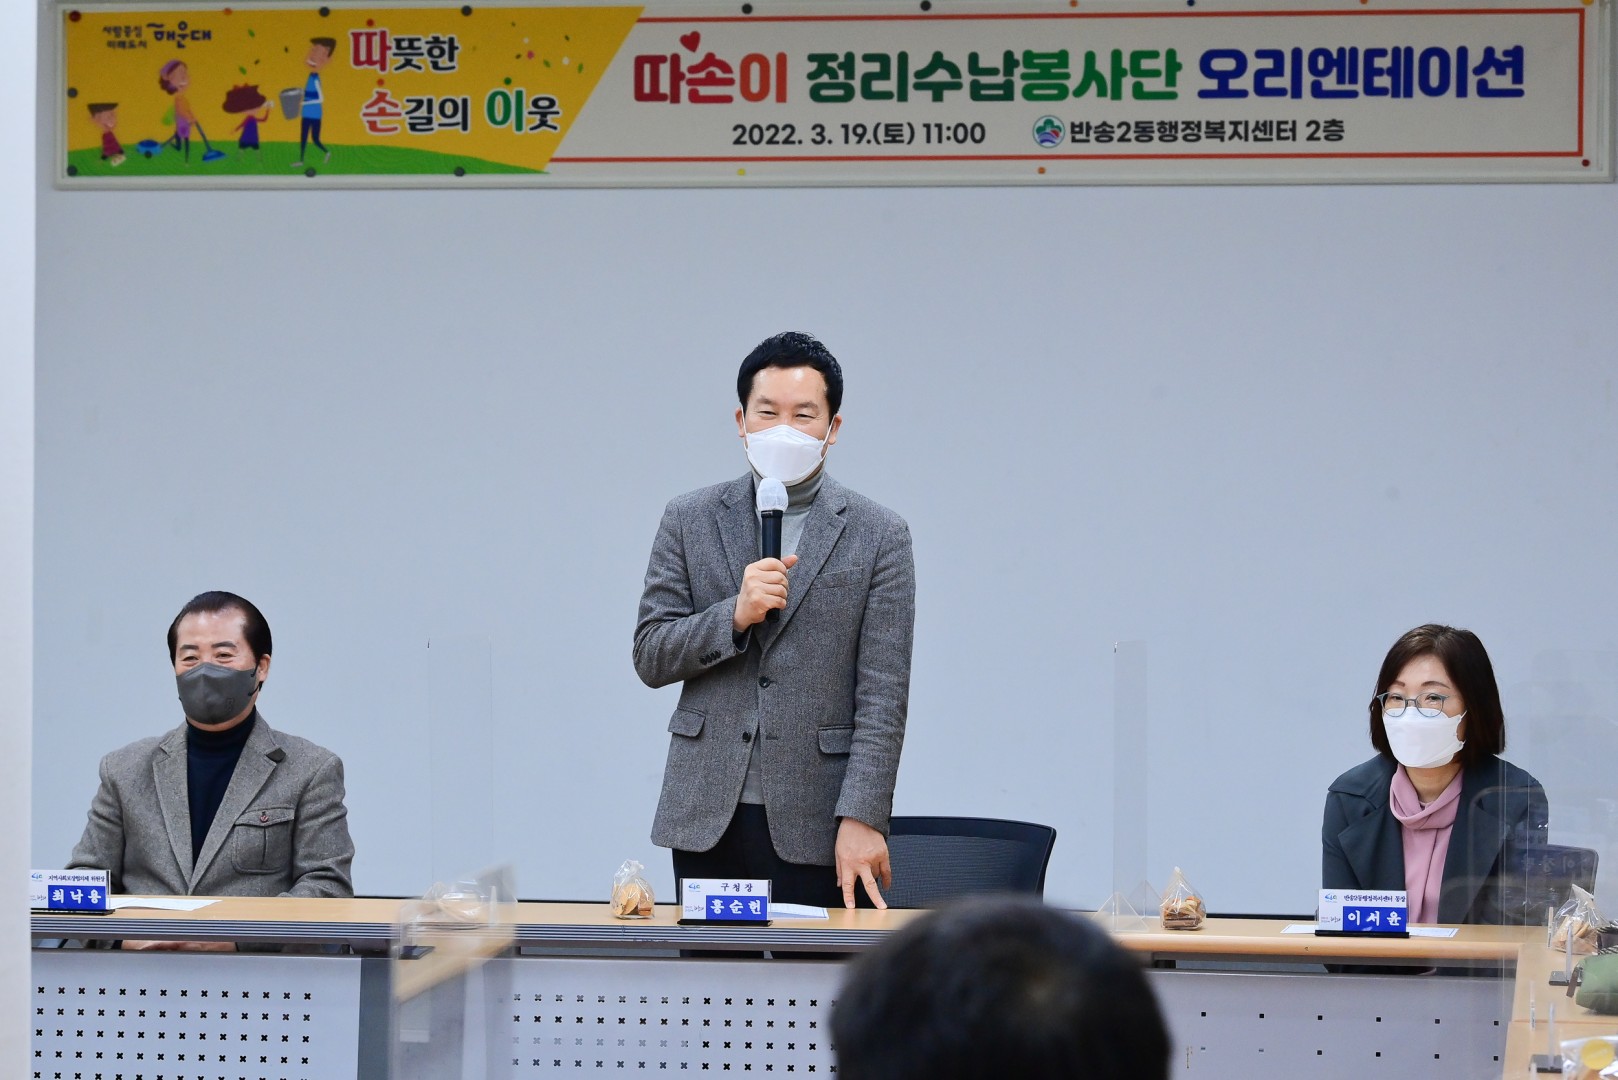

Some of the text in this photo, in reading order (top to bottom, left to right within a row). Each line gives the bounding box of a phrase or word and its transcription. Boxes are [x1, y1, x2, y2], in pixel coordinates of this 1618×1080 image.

[146, 20, 212, 49] 해운대
[350, 30, 459, 72] 따뜻한
[633, 45, 1525, 104] 따손이 정리수납봉사단 오리엔테이션
[362, 89, 561, 133] 손길의 이웃
[732, 122, 986, 146] 2022. 3. 19.(토) 11:00
[1069, 118, 1346, 145] 반송2동행정복지센터 2층
[720, 882, 753, 893] 구청장
